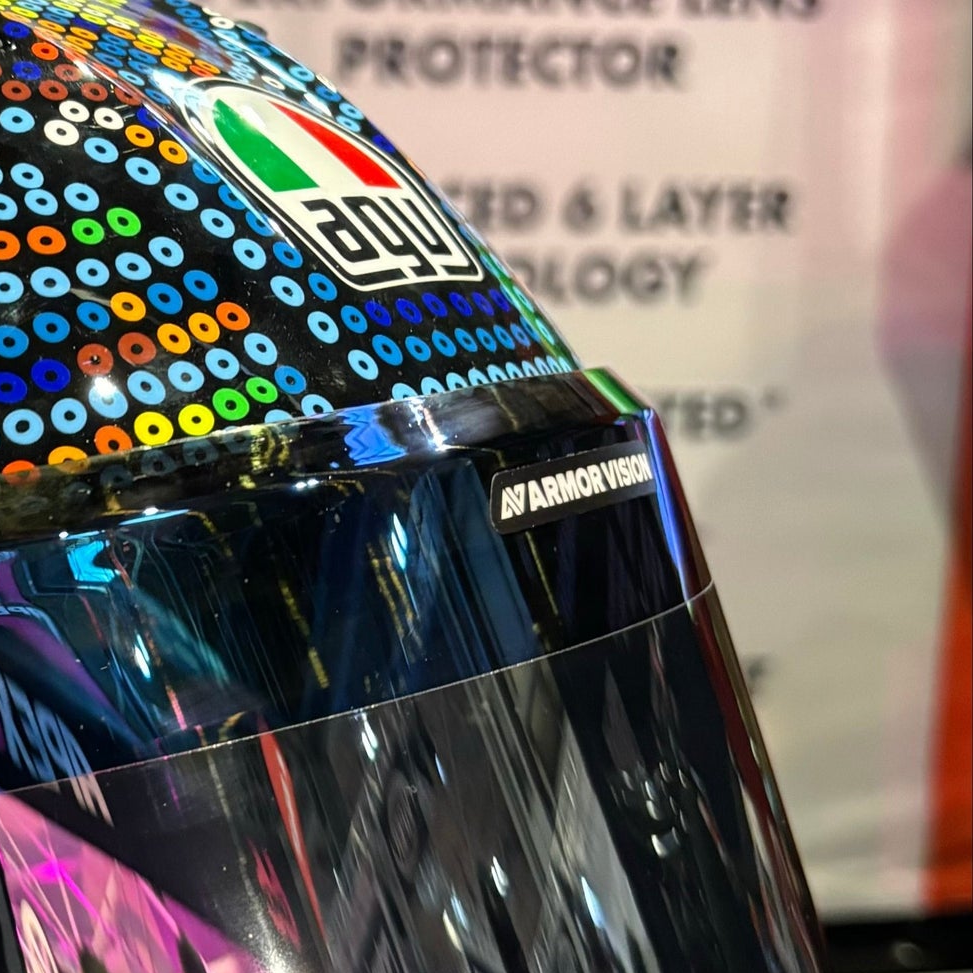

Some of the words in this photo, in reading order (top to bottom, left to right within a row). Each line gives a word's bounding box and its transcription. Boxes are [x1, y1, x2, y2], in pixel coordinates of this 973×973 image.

[337, 36, 684, 87] PROTECTOR
[563, 181, 599, 231] 6
[620, 179, 790, 232] LAYER
[528, 464, 608, 512] ARMOR
[600, 452, 653, 490] VISION
